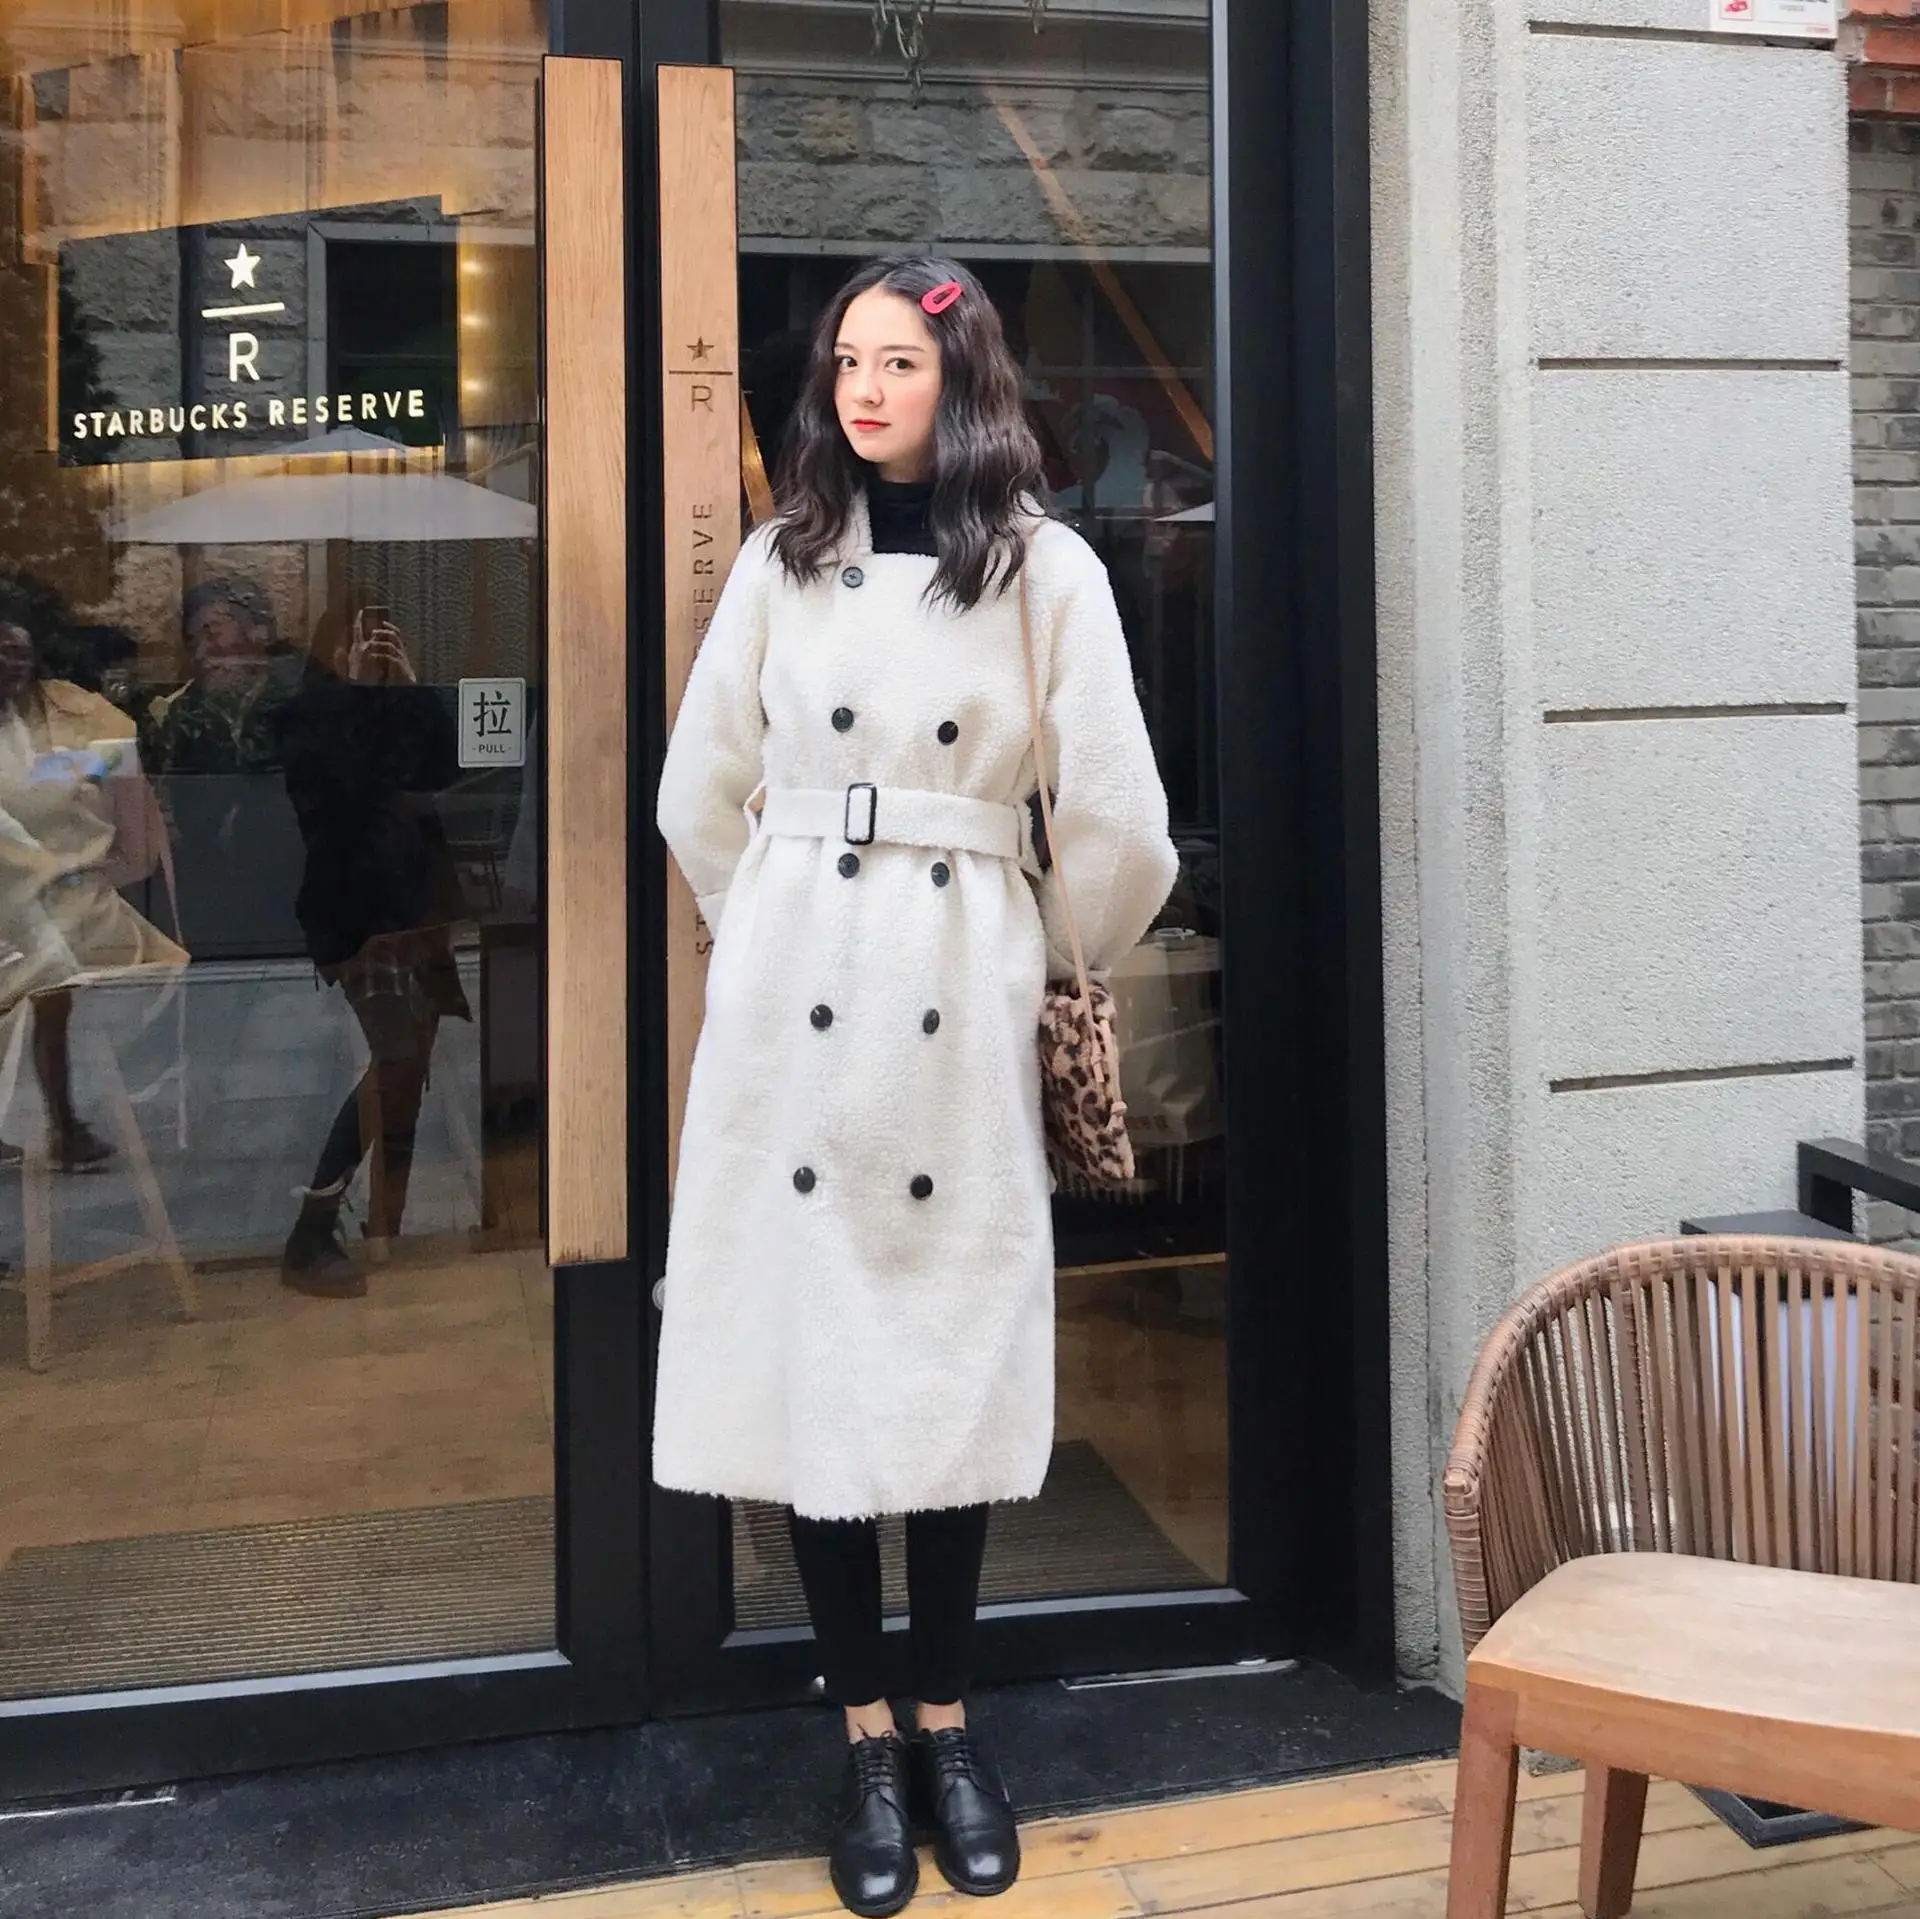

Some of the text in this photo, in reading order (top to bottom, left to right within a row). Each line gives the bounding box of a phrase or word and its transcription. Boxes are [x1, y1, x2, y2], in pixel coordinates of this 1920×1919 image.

[229, 332, 260, 382] R
[73, 389, 425, 439] STARBUCKS RESERVE
[691, 385, 714, 412] R
[473, 690, 512, 738] 拉
[478, 743, 507, 754] PULL
